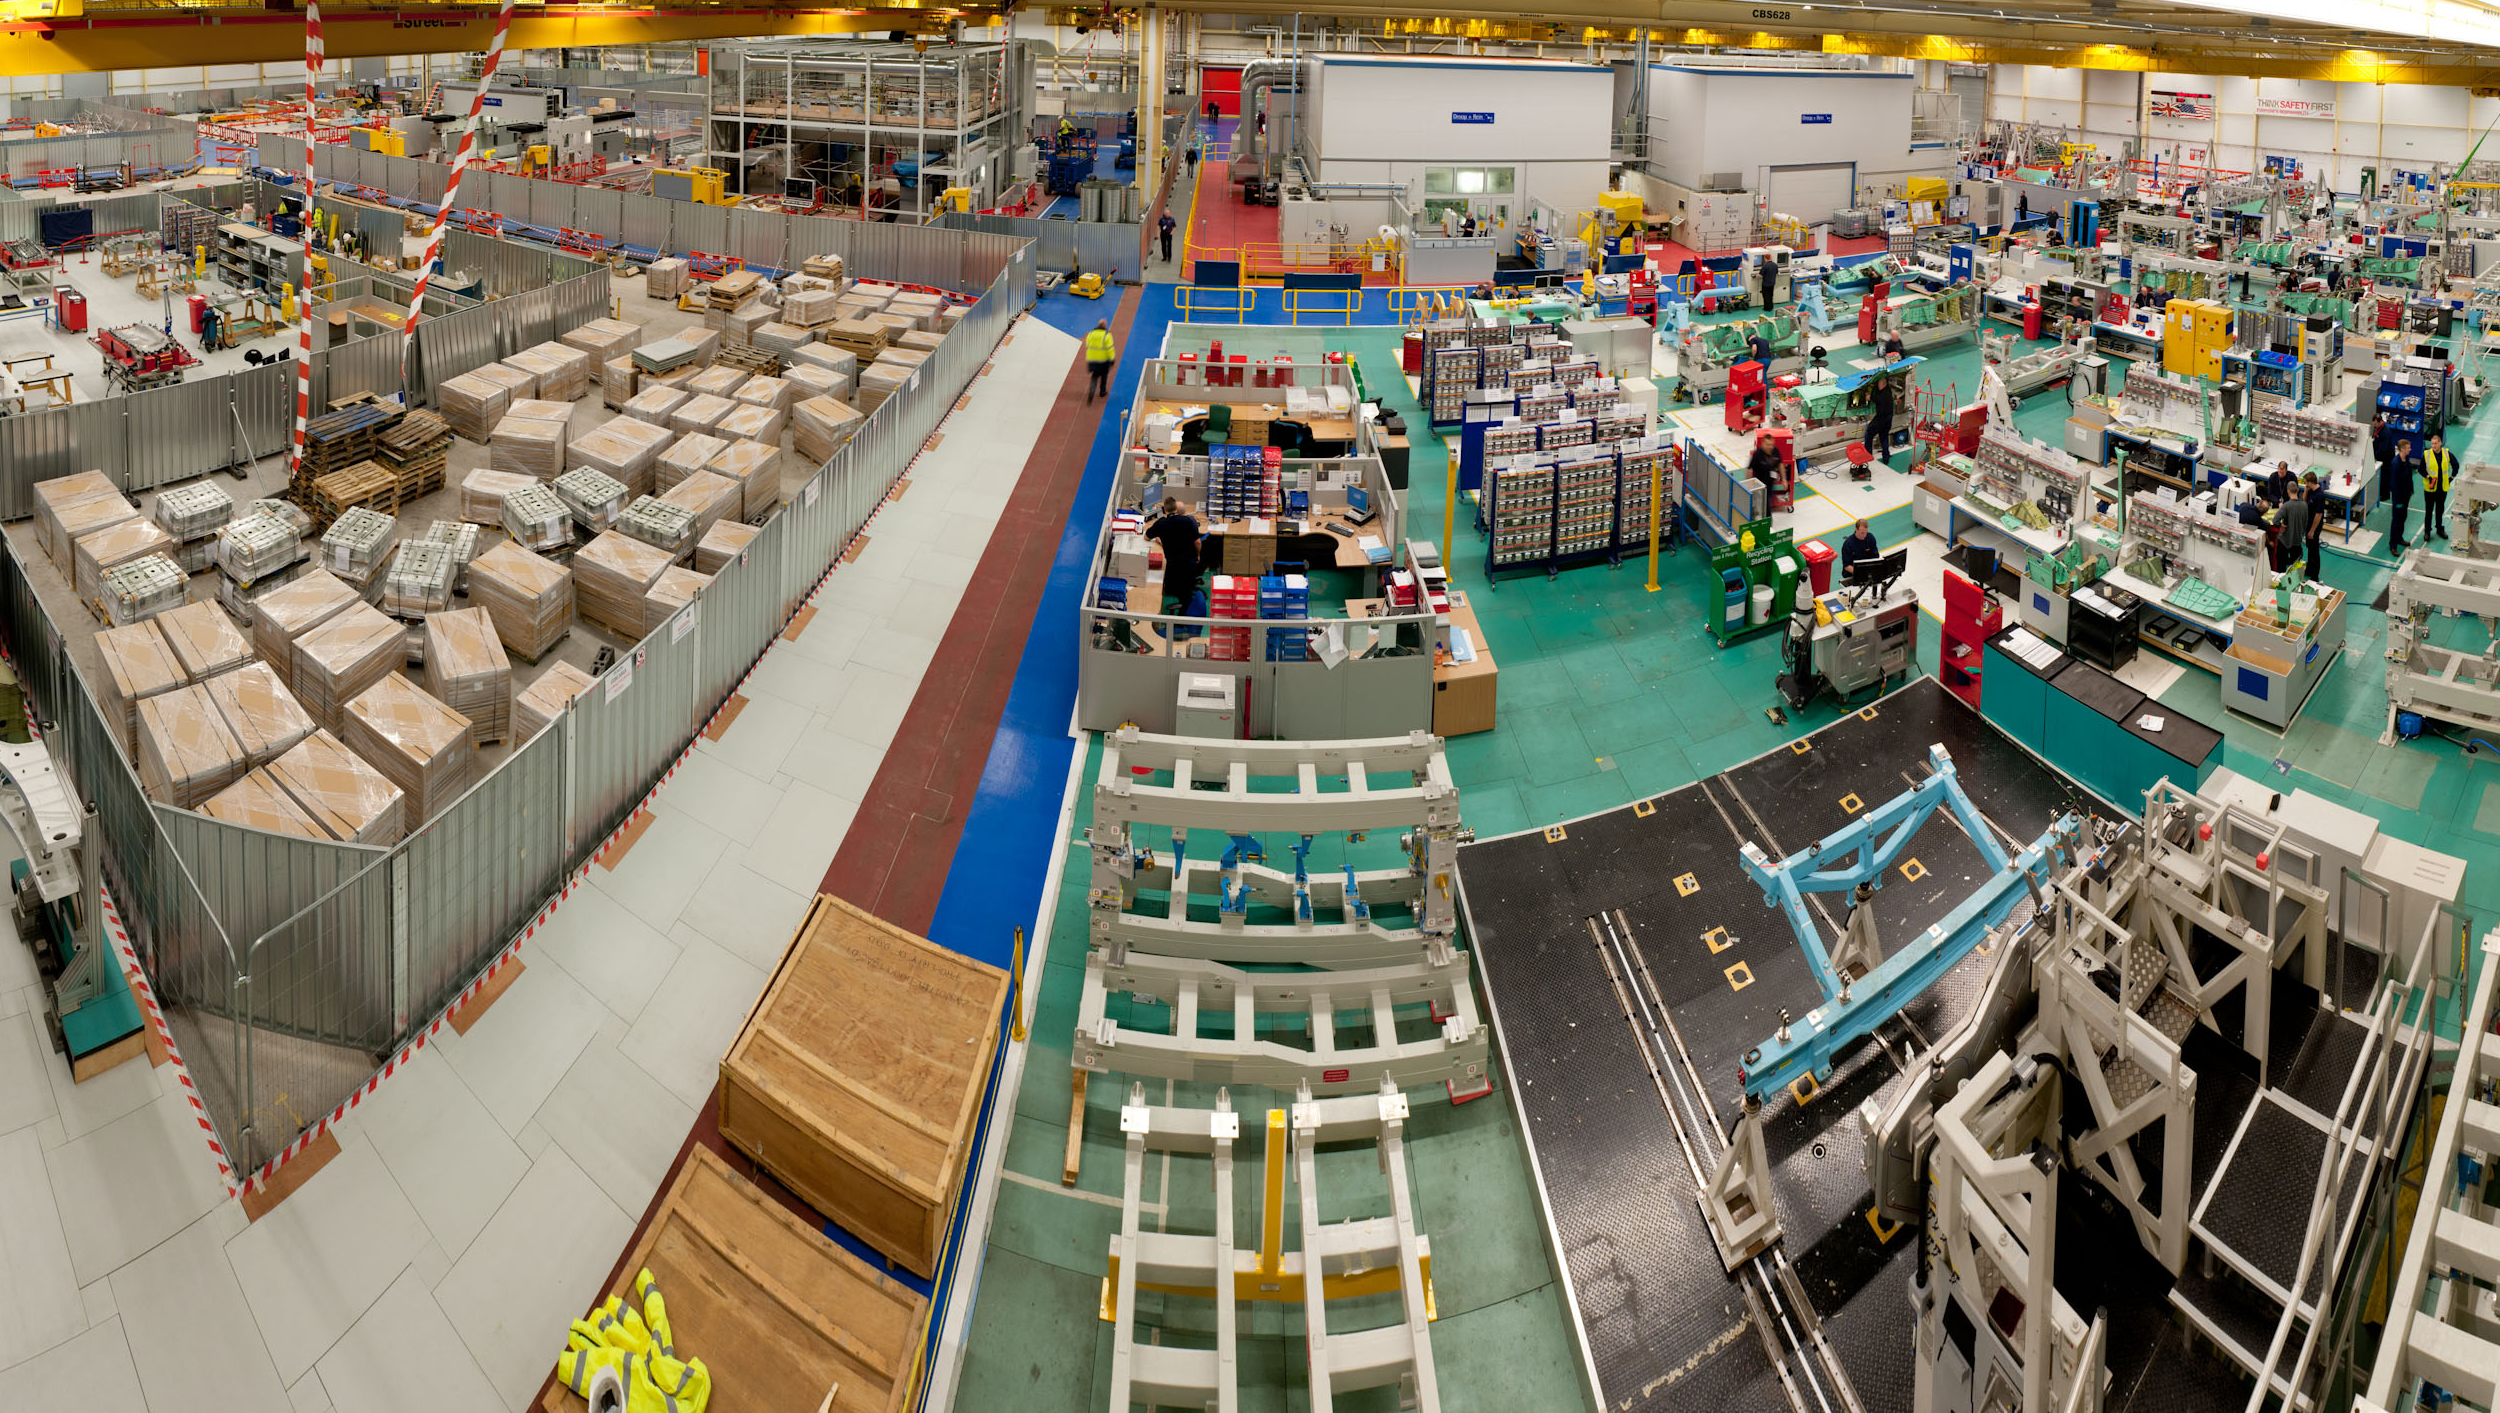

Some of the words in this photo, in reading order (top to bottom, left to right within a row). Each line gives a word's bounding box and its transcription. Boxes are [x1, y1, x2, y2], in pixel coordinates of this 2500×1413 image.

[1752, 9, 1791, 20] CBS628
[403, 19, 445, 29] Street
[2257, 99, 2279, 108] THINK
[2280, 100, 2310, 110] SAFETY
[2310, 102, 2334, 111] FIRST
[1746, 546, 1774, 559] Recycling
[1750, 554, 1772, 566] Station
